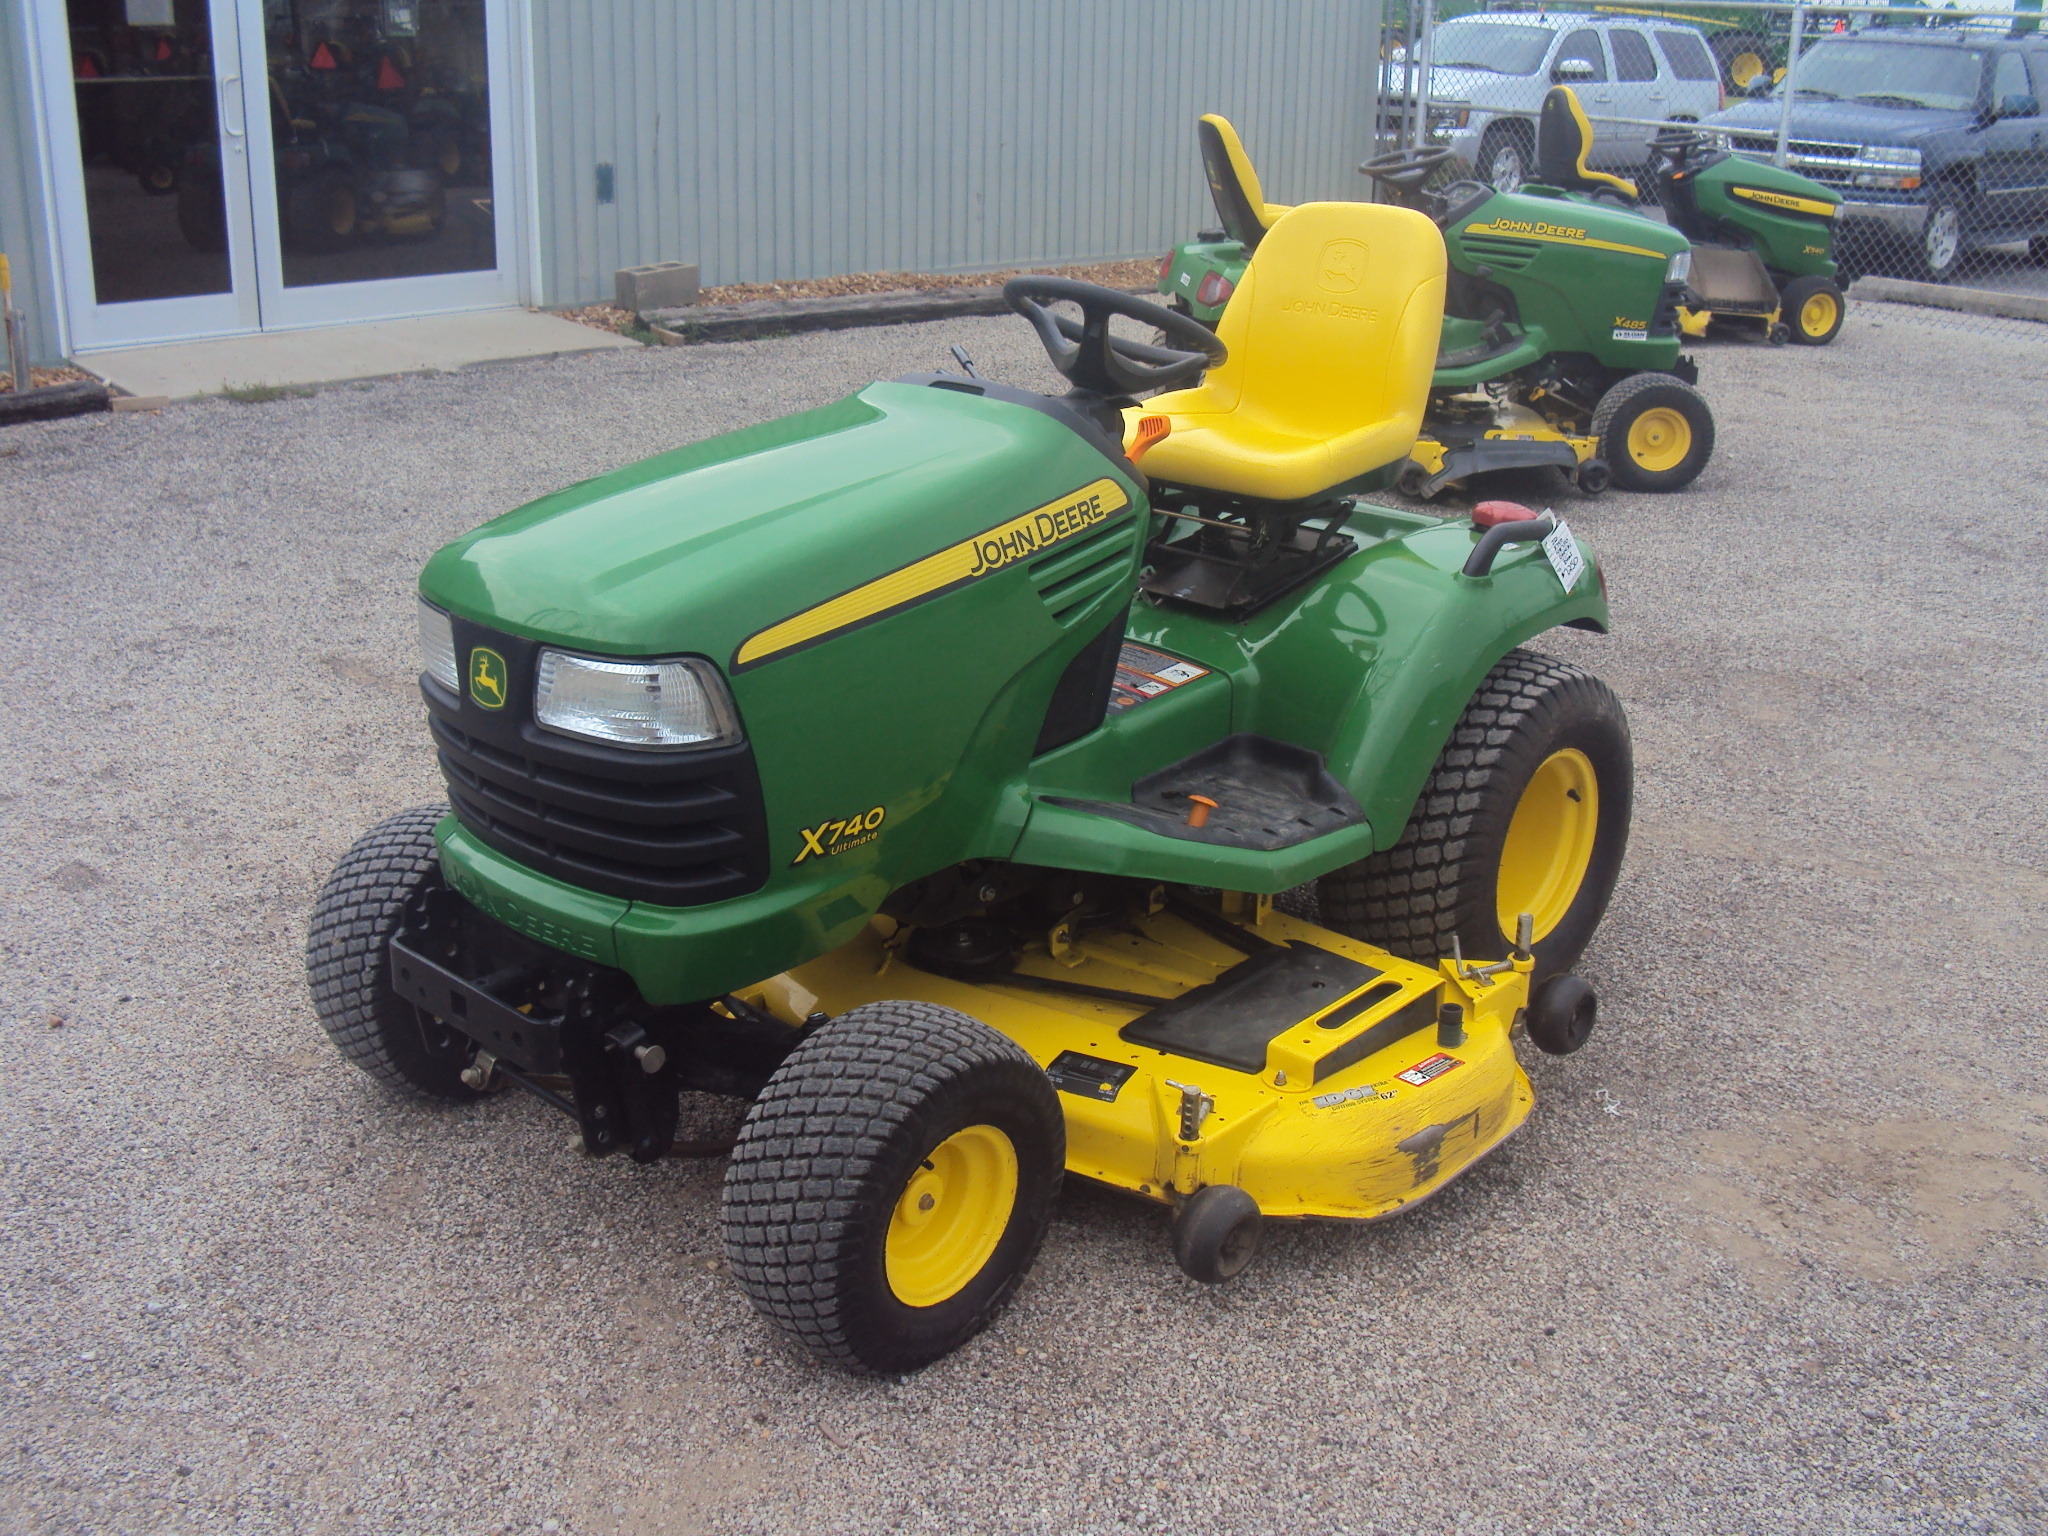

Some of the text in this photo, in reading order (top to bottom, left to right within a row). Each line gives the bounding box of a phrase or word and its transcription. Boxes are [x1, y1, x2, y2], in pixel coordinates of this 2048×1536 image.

[1748, 192, 1800, 208] JOHN DEERE
[1488, 217, 1587, 240] JOHN DEERE
[1281, 297, 1379, 323] JOHN DEERE
[1612, 316, 1648, 330] X485
[970, 494, 1105, 574] JOHN DEERE
[791, 805, 886, 864] X740
[831, 831, 878, 856] Ultimate
[505, 901, 598, 958] DEERE
